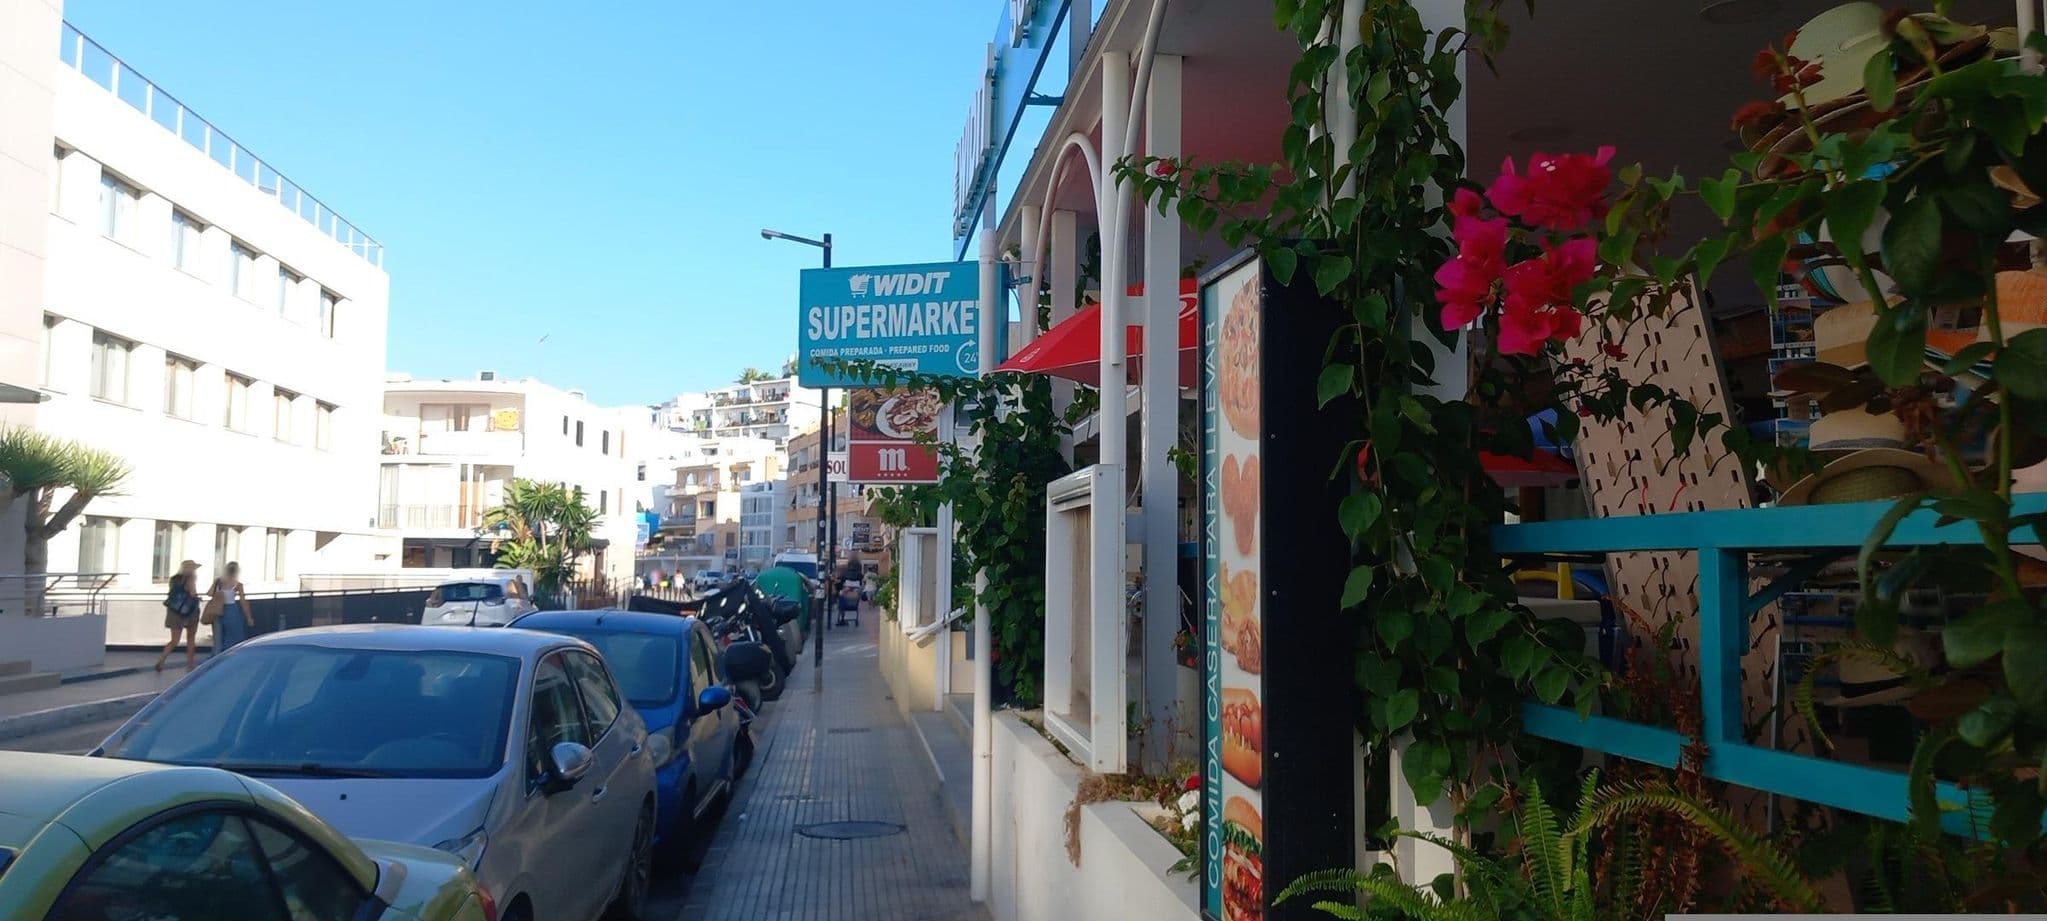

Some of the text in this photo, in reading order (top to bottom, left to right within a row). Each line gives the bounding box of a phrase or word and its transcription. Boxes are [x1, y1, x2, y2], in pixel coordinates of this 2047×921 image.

[874, 271, 950, 297] WIDIT
[808, 299, 980, 341] SUPERMARKE
[809, 344, 950, 358] COMIDA PREPARADA PREPARED FOOD
[1204, 321, 1219, 889] COMIDA CASERA PARA LLEVAR
